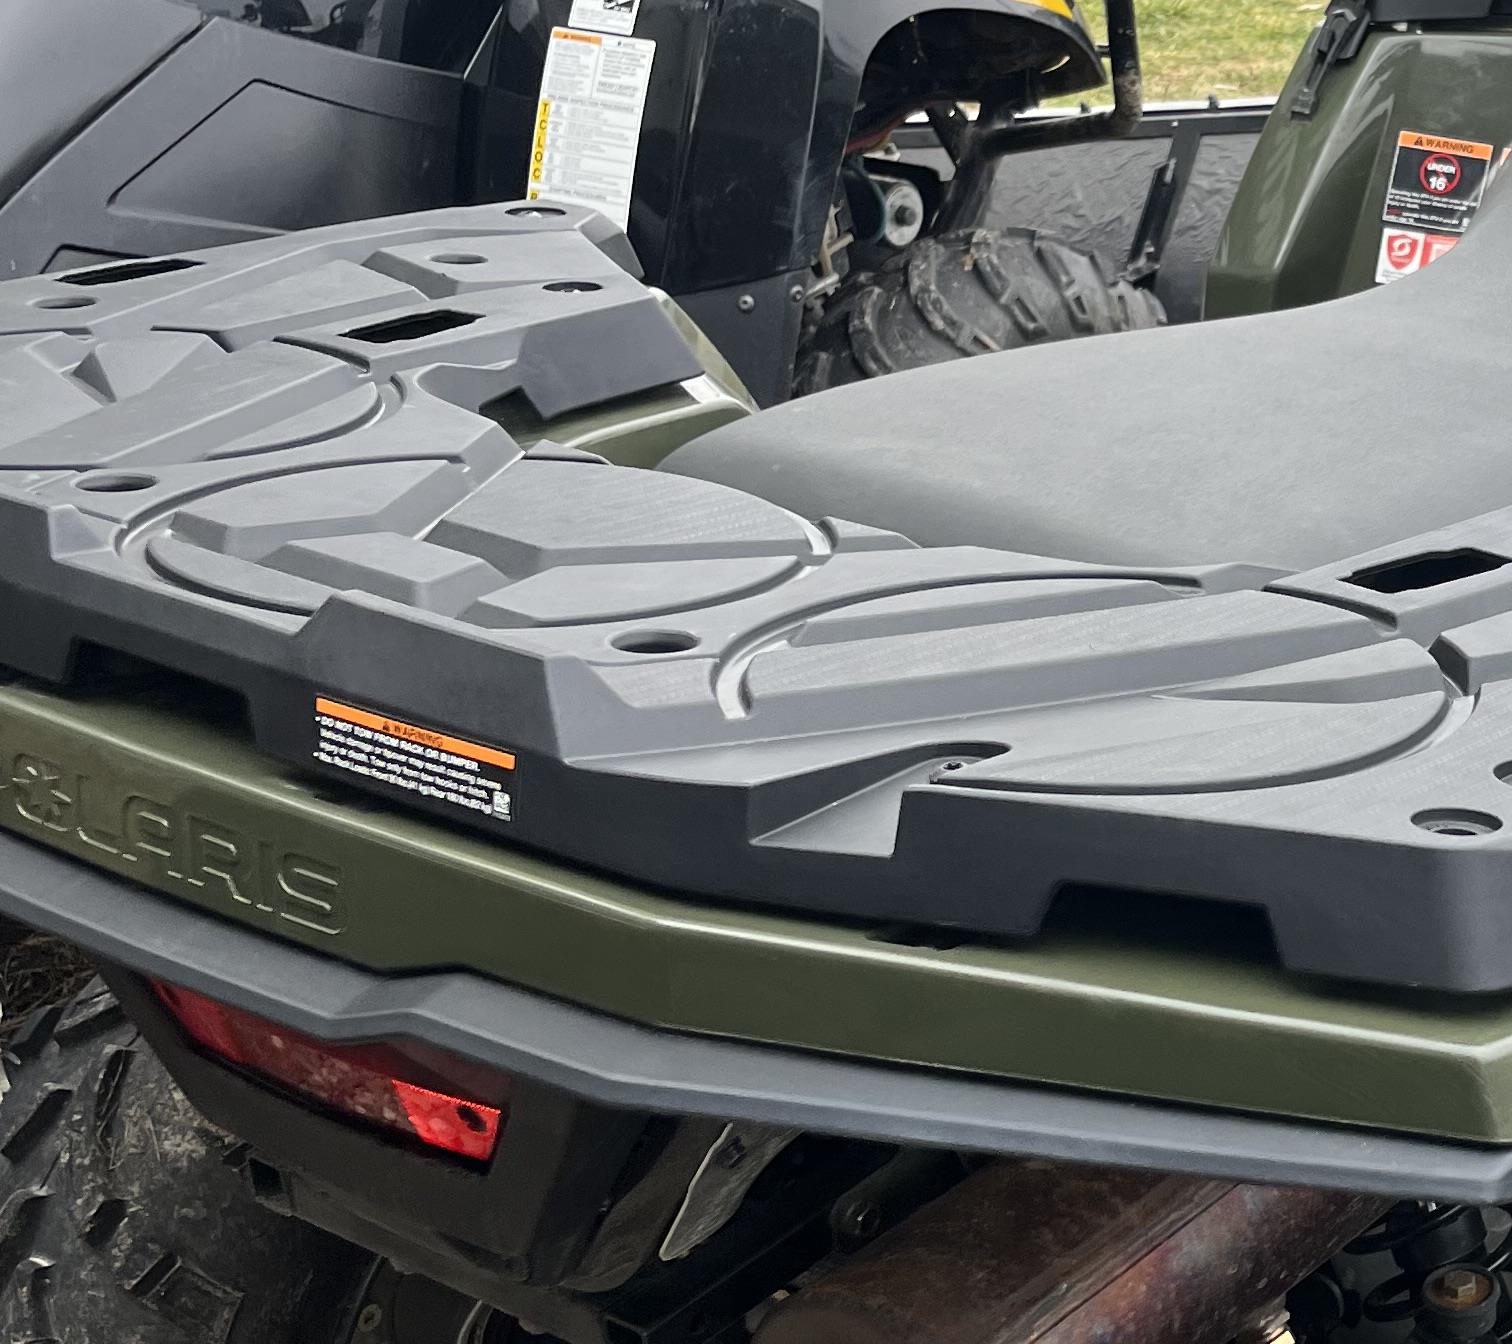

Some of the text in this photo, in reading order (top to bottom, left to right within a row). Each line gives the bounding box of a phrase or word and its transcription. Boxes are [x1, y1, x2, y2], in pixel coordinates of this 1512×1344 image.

[1425, 138, 1475, 155] WARNING
[1429, 176, 1448, 192] 16
[0, 753, 346, 935] OLARIS
